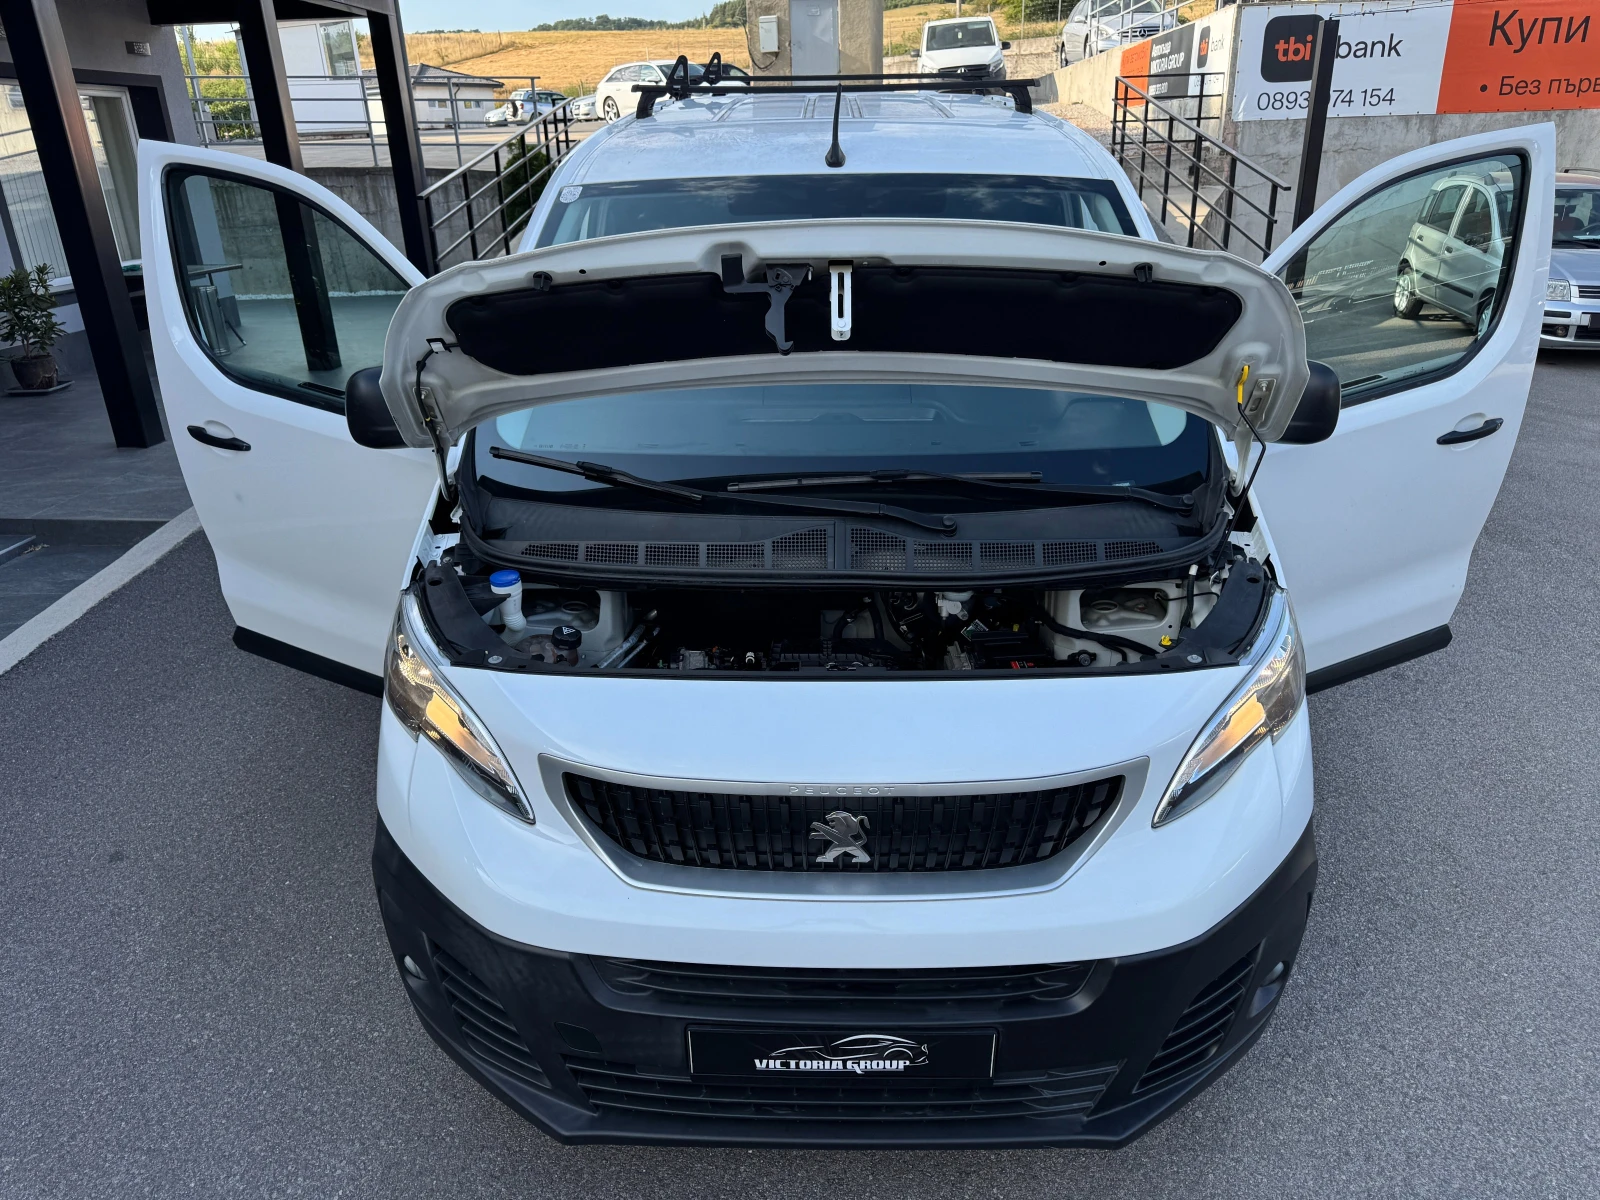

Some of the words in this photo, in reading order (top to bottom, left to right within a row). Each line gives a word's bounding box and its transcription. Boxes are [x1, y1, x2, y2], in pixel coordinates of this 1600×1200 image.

[1488, 9, 1591, 54] Купи
[1274, 34, 1313, 62] tbi
[1335, 33, 1403, 59] bank
[1498, 75, 1542, 96] Без
[1257, 90, 1312, 111] 0893
[1361, 87, 1396, 107] 154
[788, 785, 896, 795] PEUGEOT
[753, 1059, 845, 1070] VICTORIA
[846, 1059, 910, 1074] GROUP
